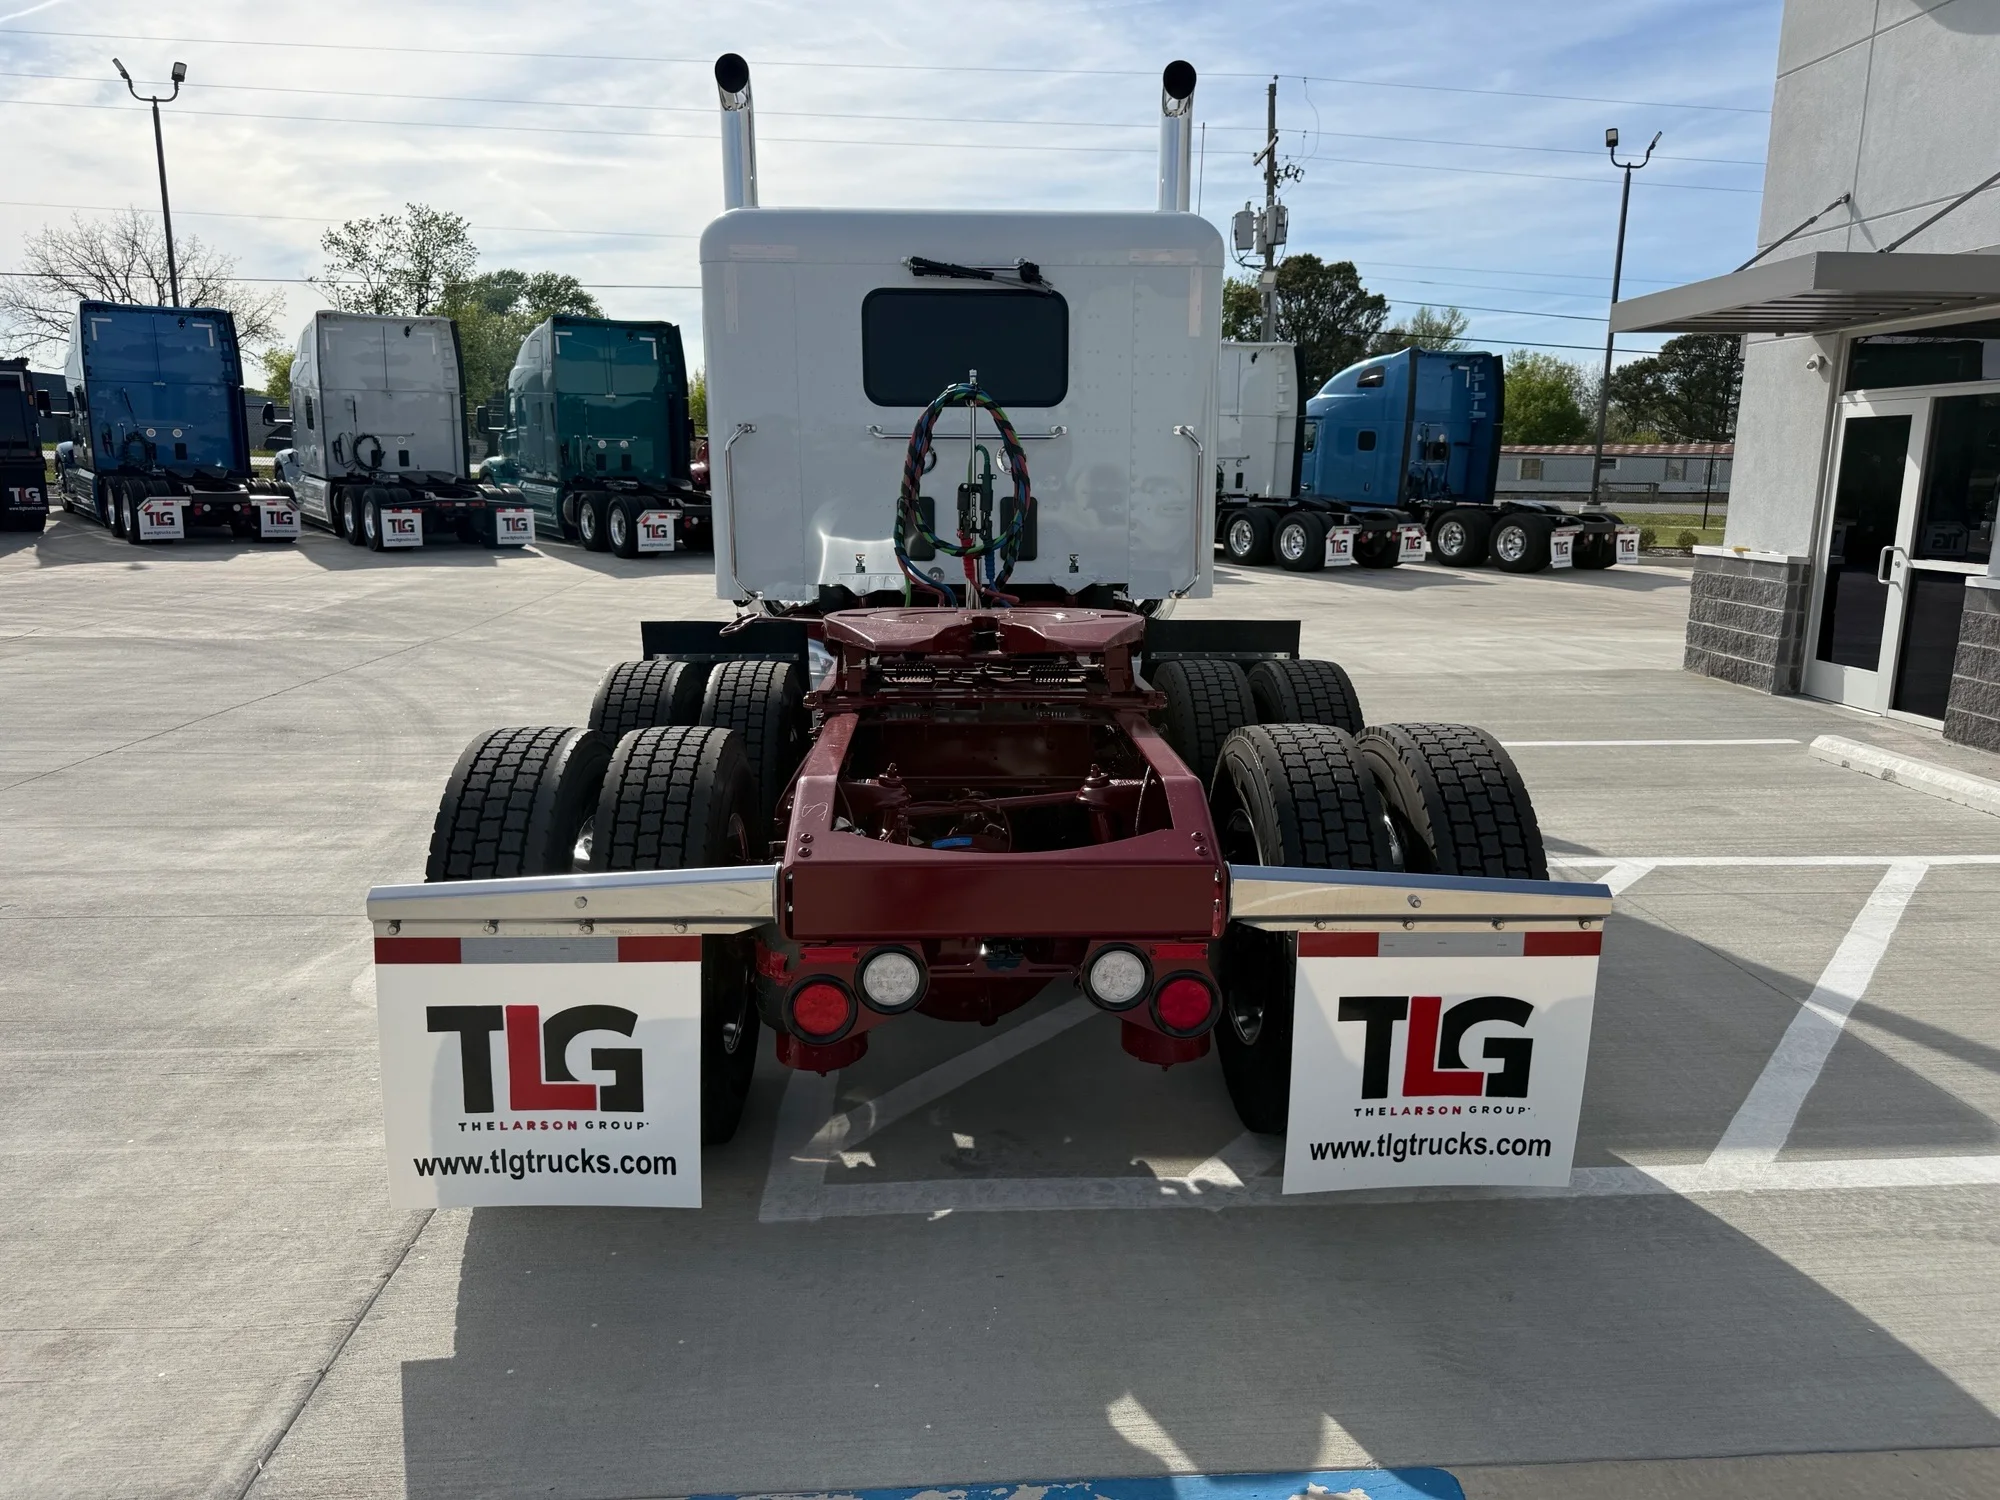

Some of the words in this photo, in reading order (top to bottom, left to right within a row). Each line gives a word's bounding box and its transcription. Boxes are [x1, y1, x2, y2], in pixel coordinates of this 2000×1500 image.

[9, 487, 41, 502] TLG
[145, 511, 175, 526] TLG
[266, 511, 294, 525] TLG
[387, 518, 415, 533] TLG
[502, 517, 528, 532] TLG
[643, 524, 667, 539] TLG
[1330, 540, 1348, 553] TLG
[1405, 536, 1422, 550] TLG
[1553, 541, 1569, 555] TLG
[1620, 539, 1635, 553] TLG
[1337, 995, 1535, 1100] TLG
[426, 1004, 644, 1113] TLG
[1468, 1105, 1526, 1115] GROUP
[584, 1120, 645, 1130] GROUP
[1309, 1131, 1552, 1163] www.tlgtrucks.com
[413, 1148, 677, 1180] www.tlgtrucks.com
